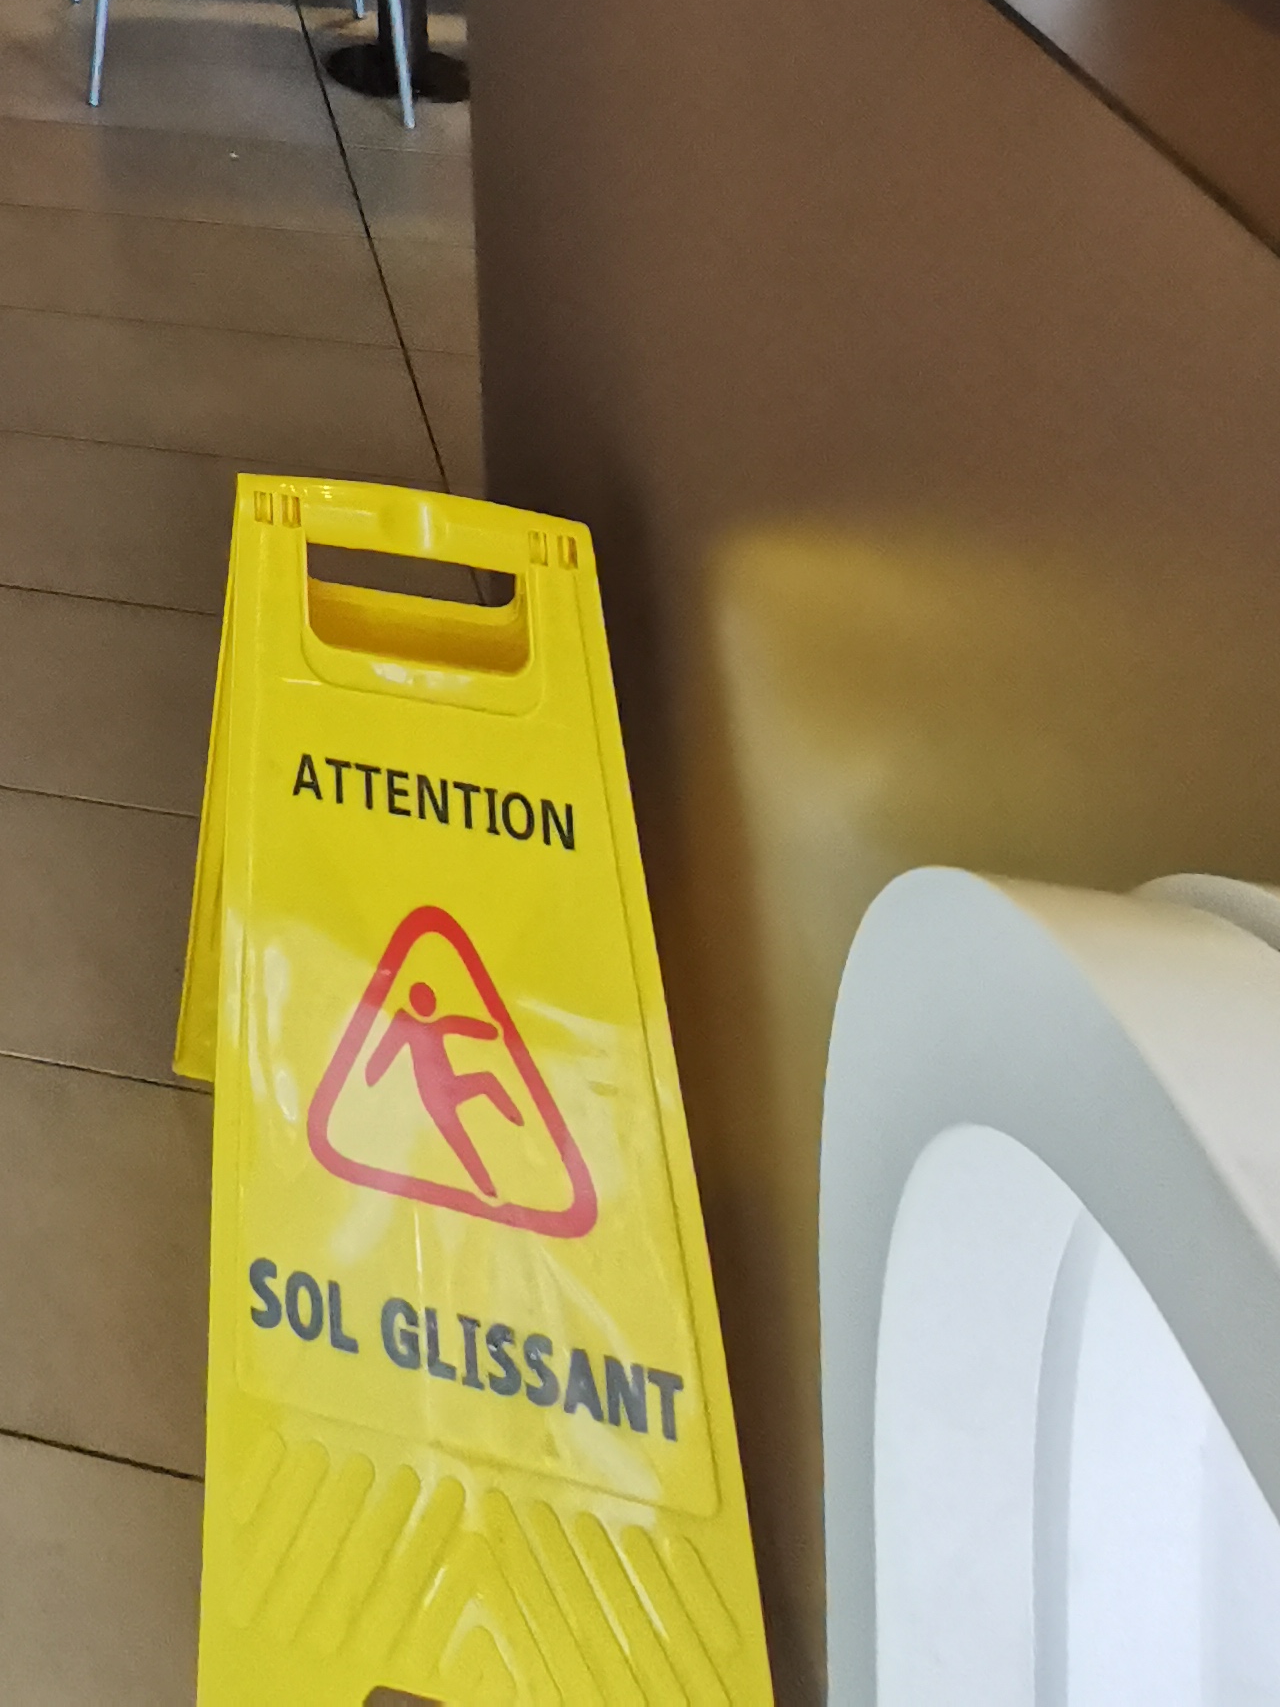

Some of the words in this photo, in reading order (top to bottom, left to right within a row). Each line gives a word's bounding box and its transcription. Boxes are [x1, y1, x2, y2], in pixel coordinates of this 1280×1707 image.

[292, 752, 576, 852] ATTENTION
[248, 1257, 359, 1354] SOL
[380, 1296, 685, 1442] GLISSANT
